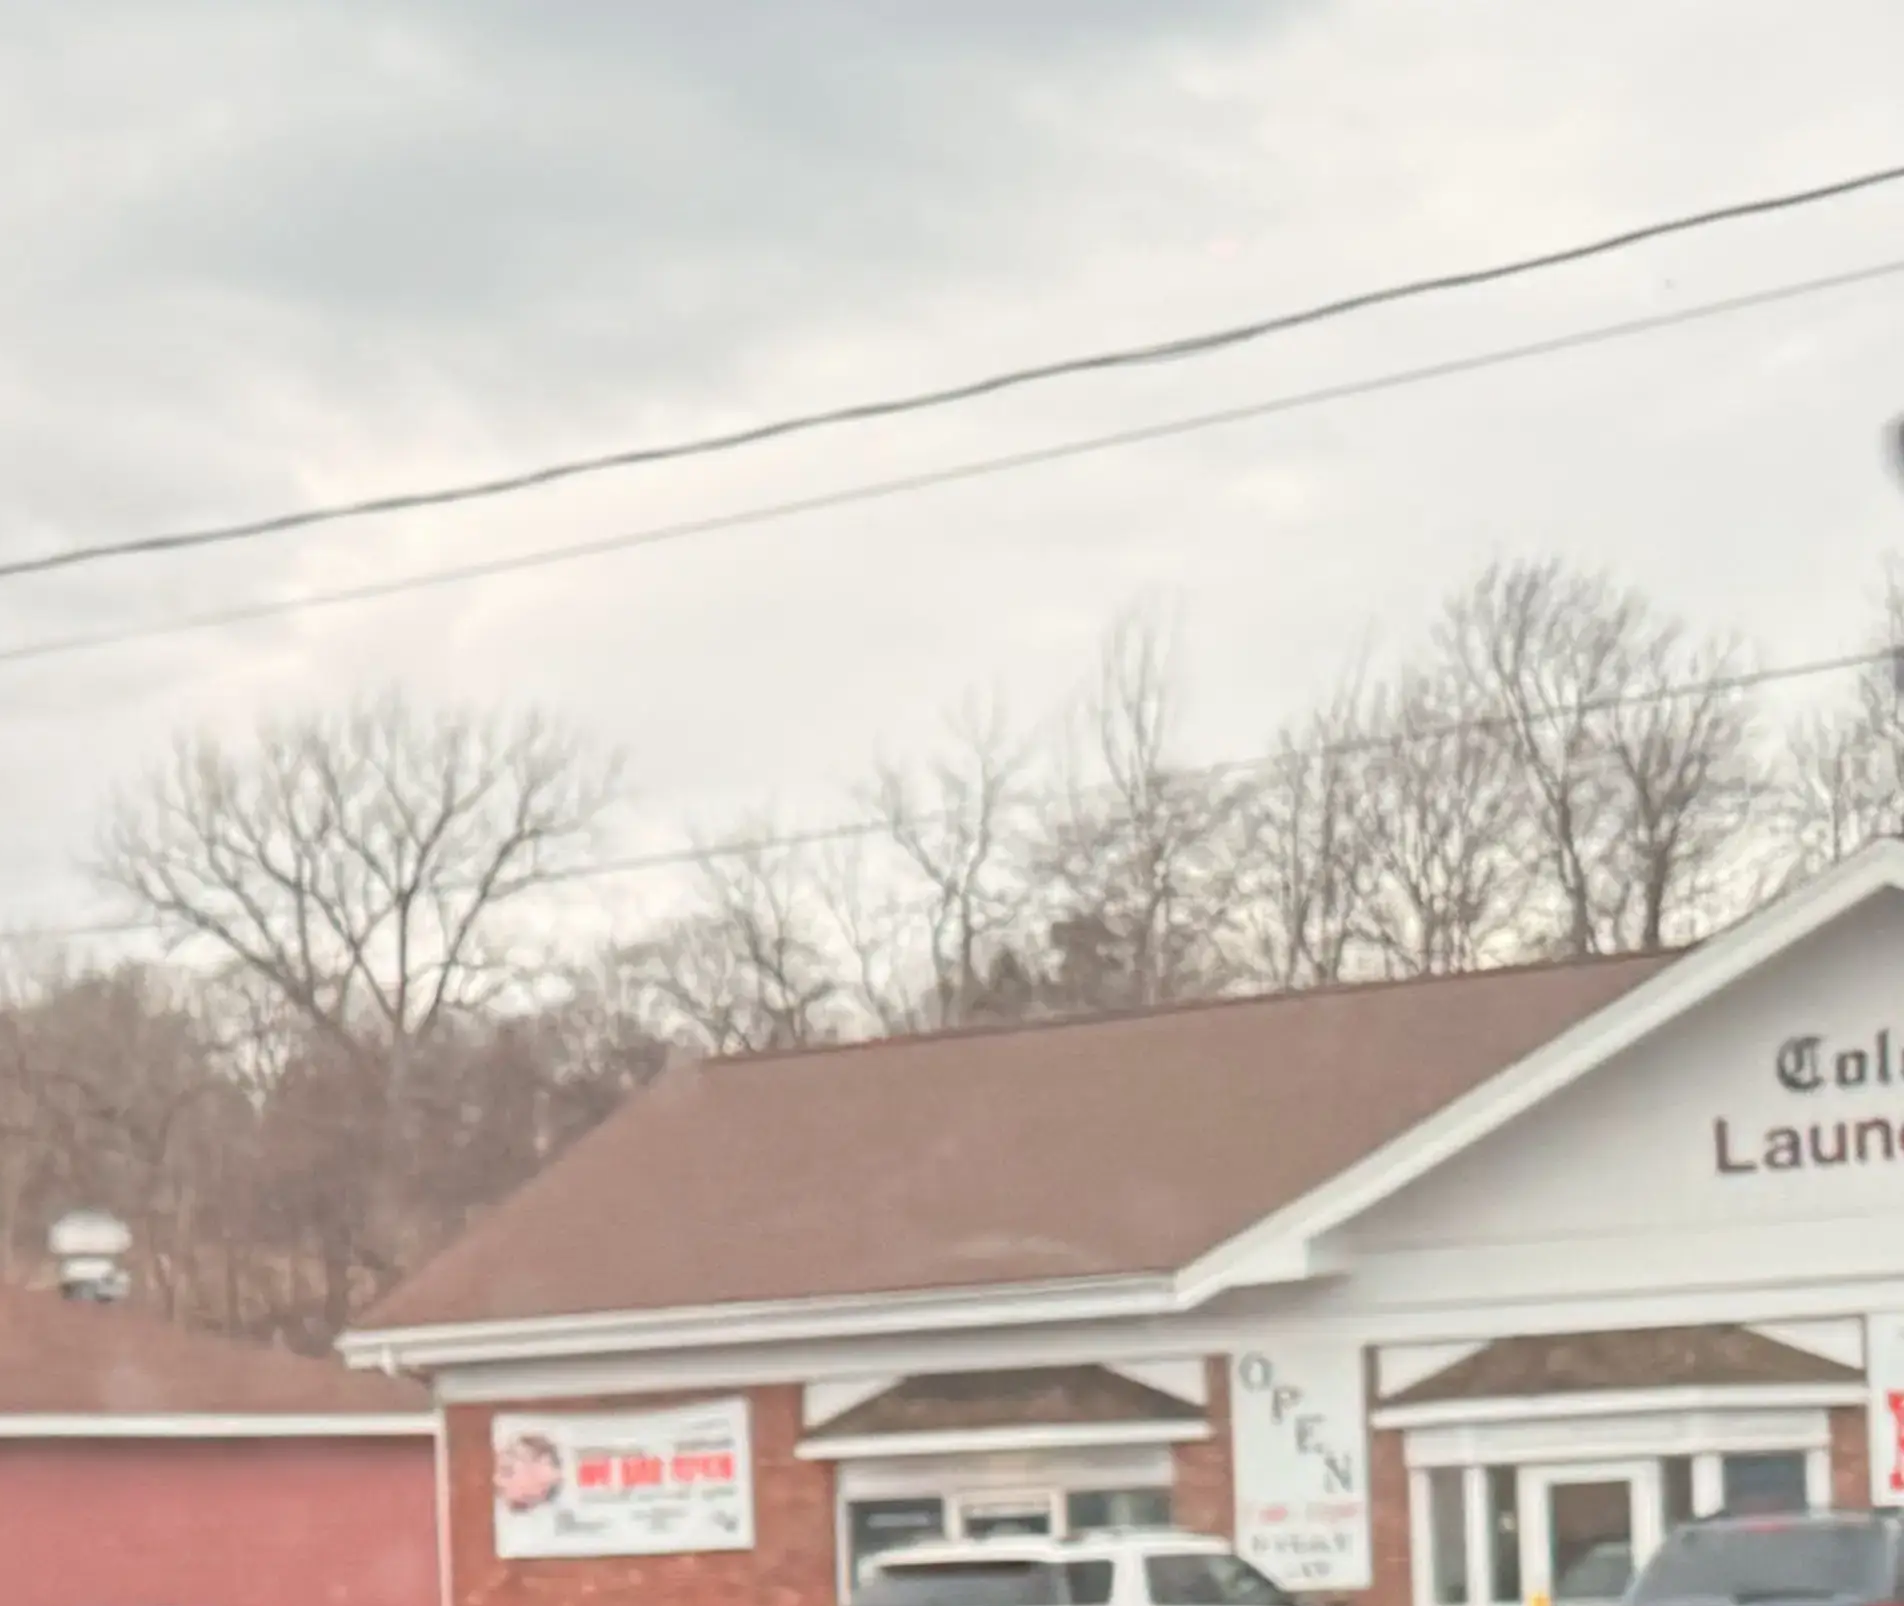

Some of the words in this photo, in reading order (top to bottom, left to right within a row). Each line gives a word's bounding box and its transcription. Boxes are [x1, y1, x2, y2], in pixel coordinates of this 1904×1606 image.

[1776, 1028, 1904, 1092] Col
[1714, 1115, 1904, 1174] Laun
[1239, 1352, 1353, 1494] OPEN
